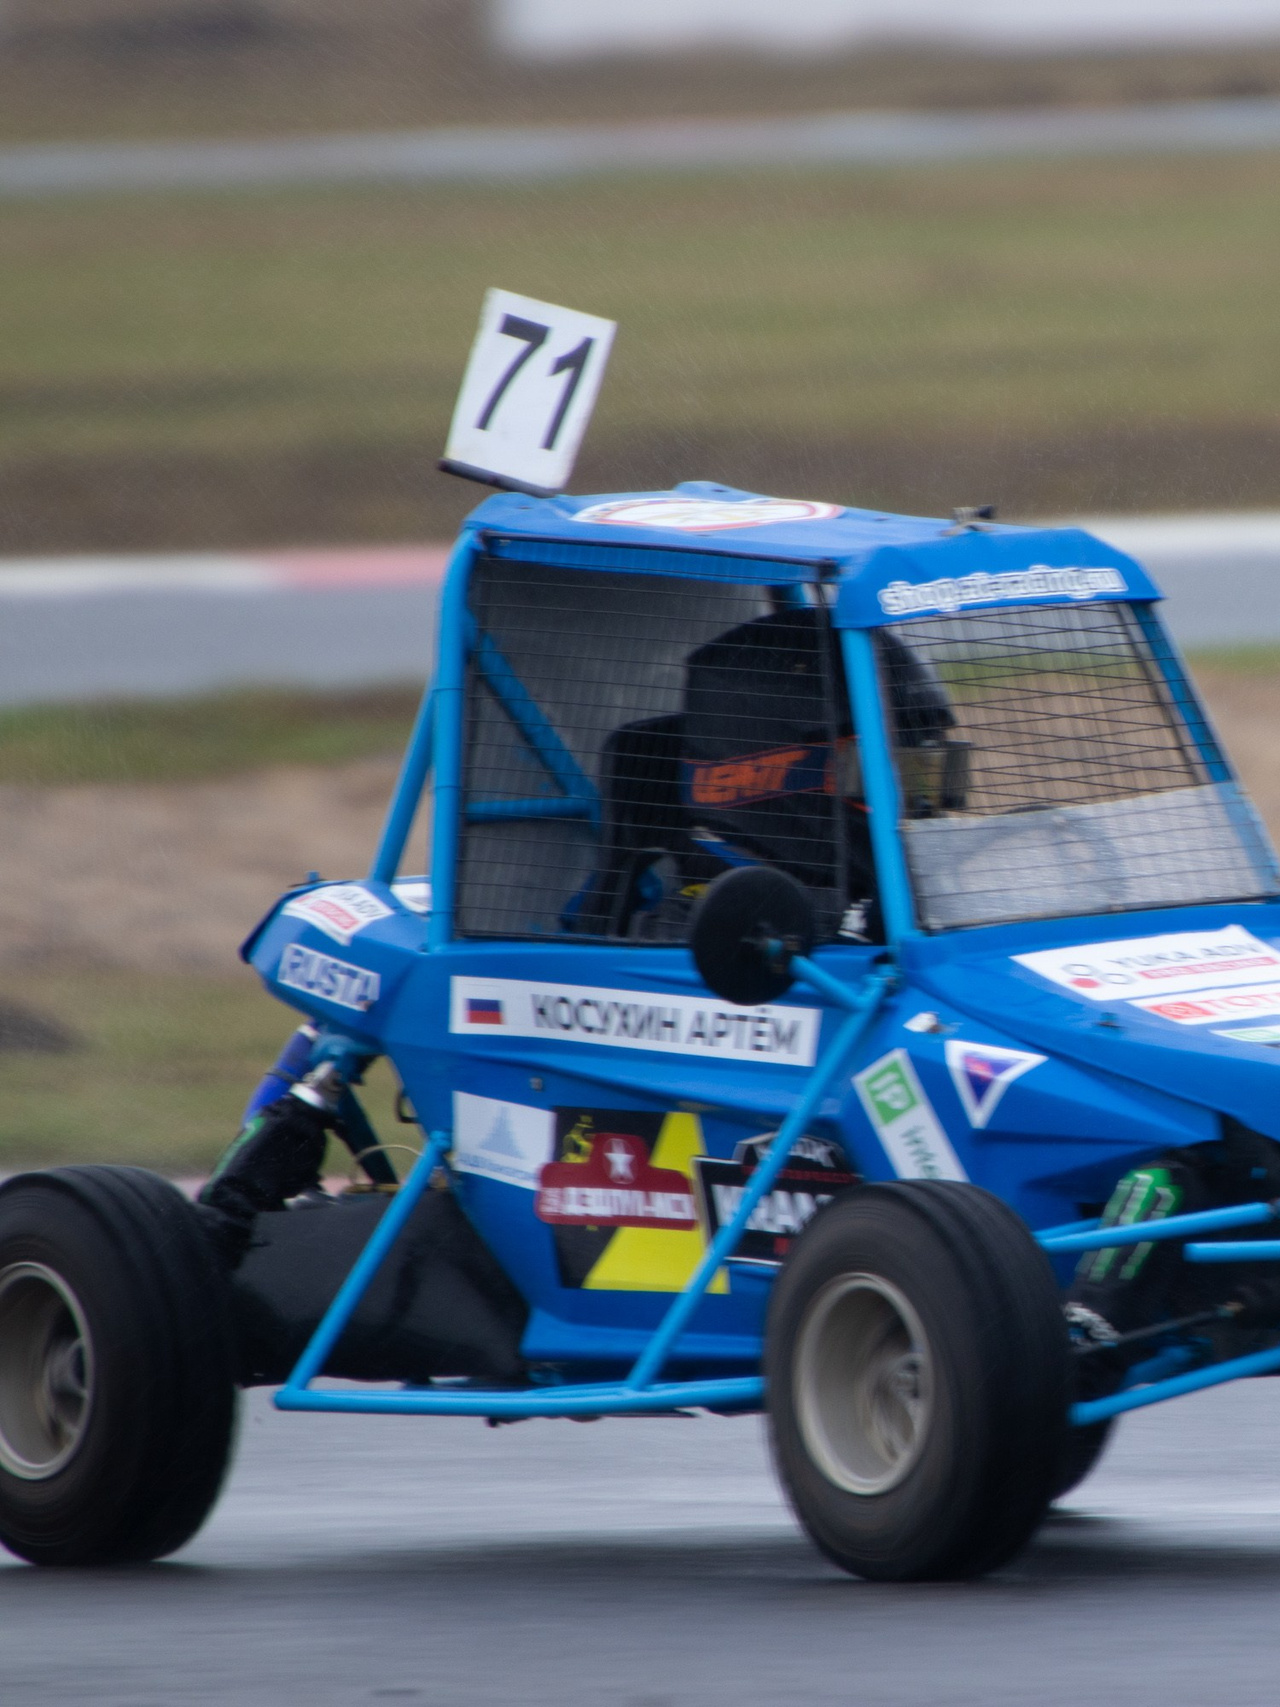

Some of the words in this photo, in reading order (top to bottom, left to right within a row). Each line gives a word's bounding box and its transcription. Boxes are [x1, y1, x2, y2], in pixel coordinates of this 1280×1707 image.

[475, 313, 595, 451] 71
[530, 993, 681, 1042] КОСУХИН
[687, 1006, 803, 1055] АРТЁМ
